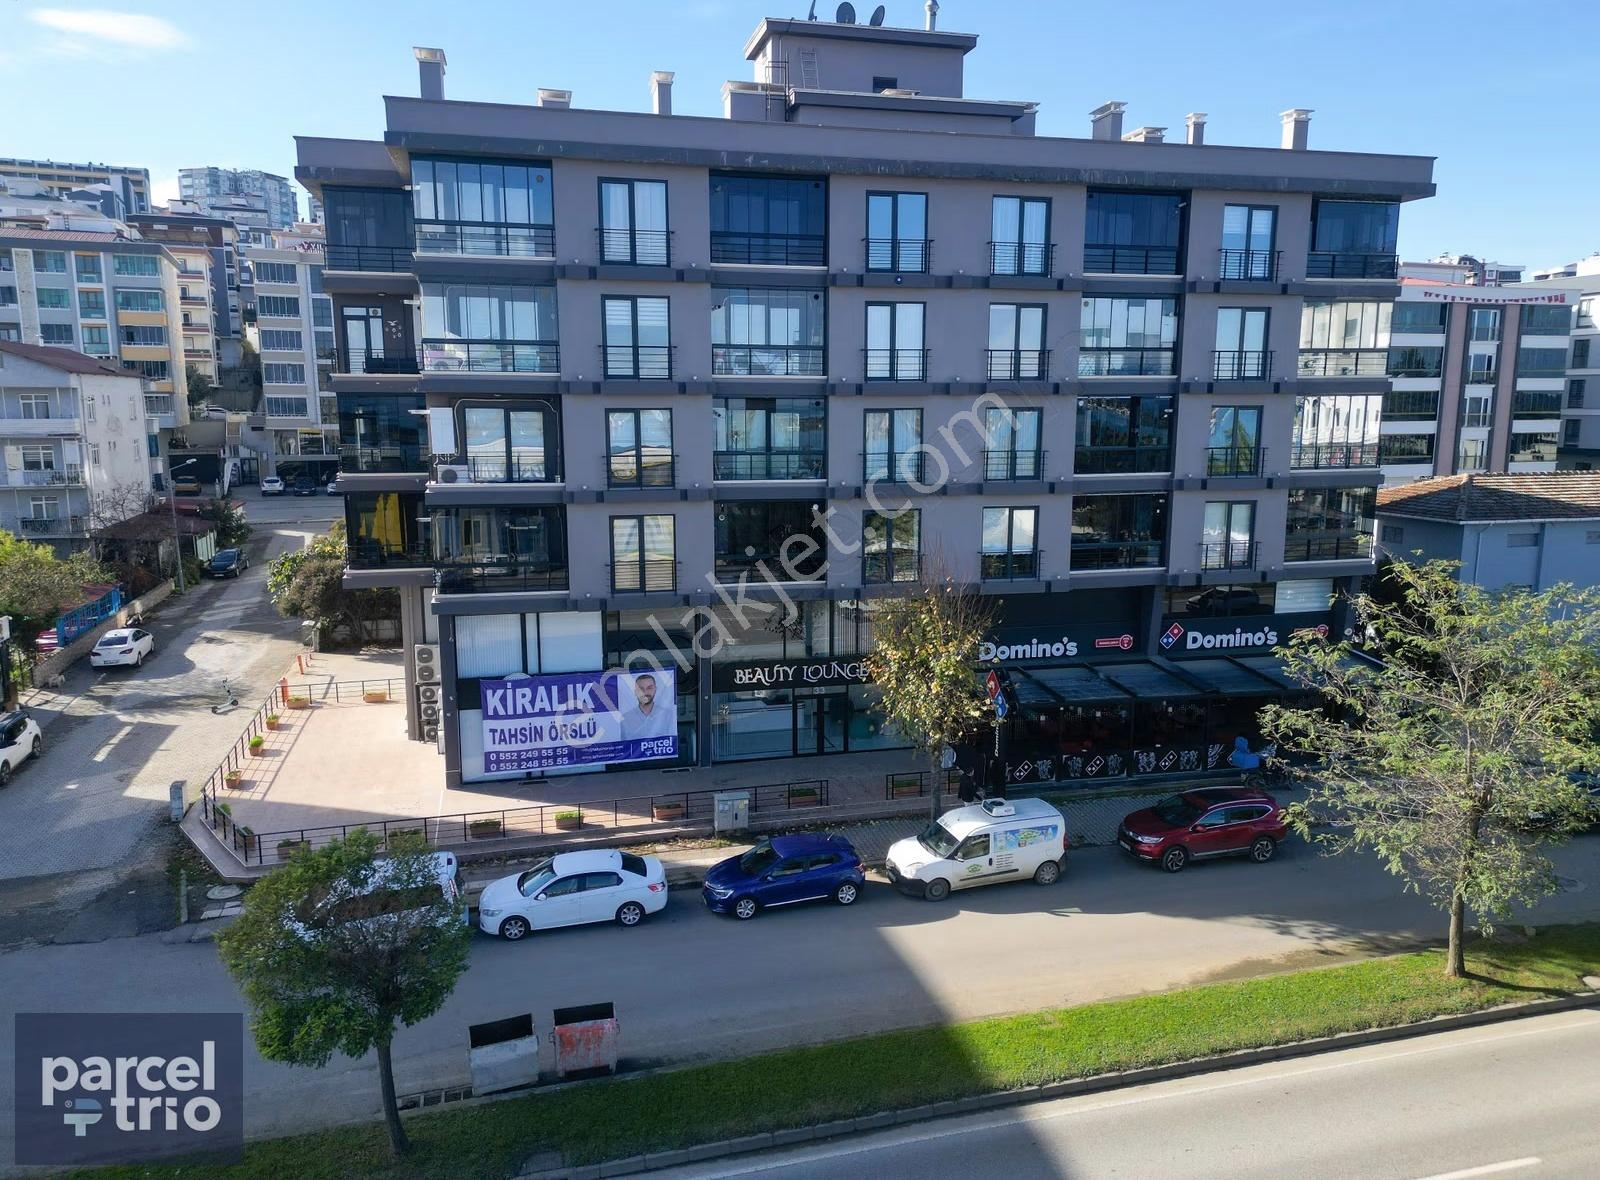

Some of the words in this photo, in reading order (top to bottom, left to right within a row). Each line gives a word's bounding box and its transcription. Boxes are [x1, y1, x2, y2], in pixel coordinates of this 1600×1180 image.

[979, 636, 1078, 661] Domino's
[1186, 626, 1278, 650] Domino's
[734, 664, 798, 686] BEAUTY
[802, 661, 869, 683] LOUNGE
[486, 682, 595, 716] KİRALIK
[489, 722, 543, 745] TAHSİN
[548, 718, 597, 741] ÖRSLÜ
[490, 753, 497, 761] 0
[500, 752, 518, 760] 552
[520, 750, 539, 759] 249
[541, 748, 554, 757] 55
[556, 747, 568, 755] 55
[640, 736, 673, 752] parcel
[653, 745, 674, 754] trio
[490, 763, 497, 771] 0
[500, 762, 518, 770] 552
[541, 759, 554, 767] 55
[556, 757, 569, 765] 55
